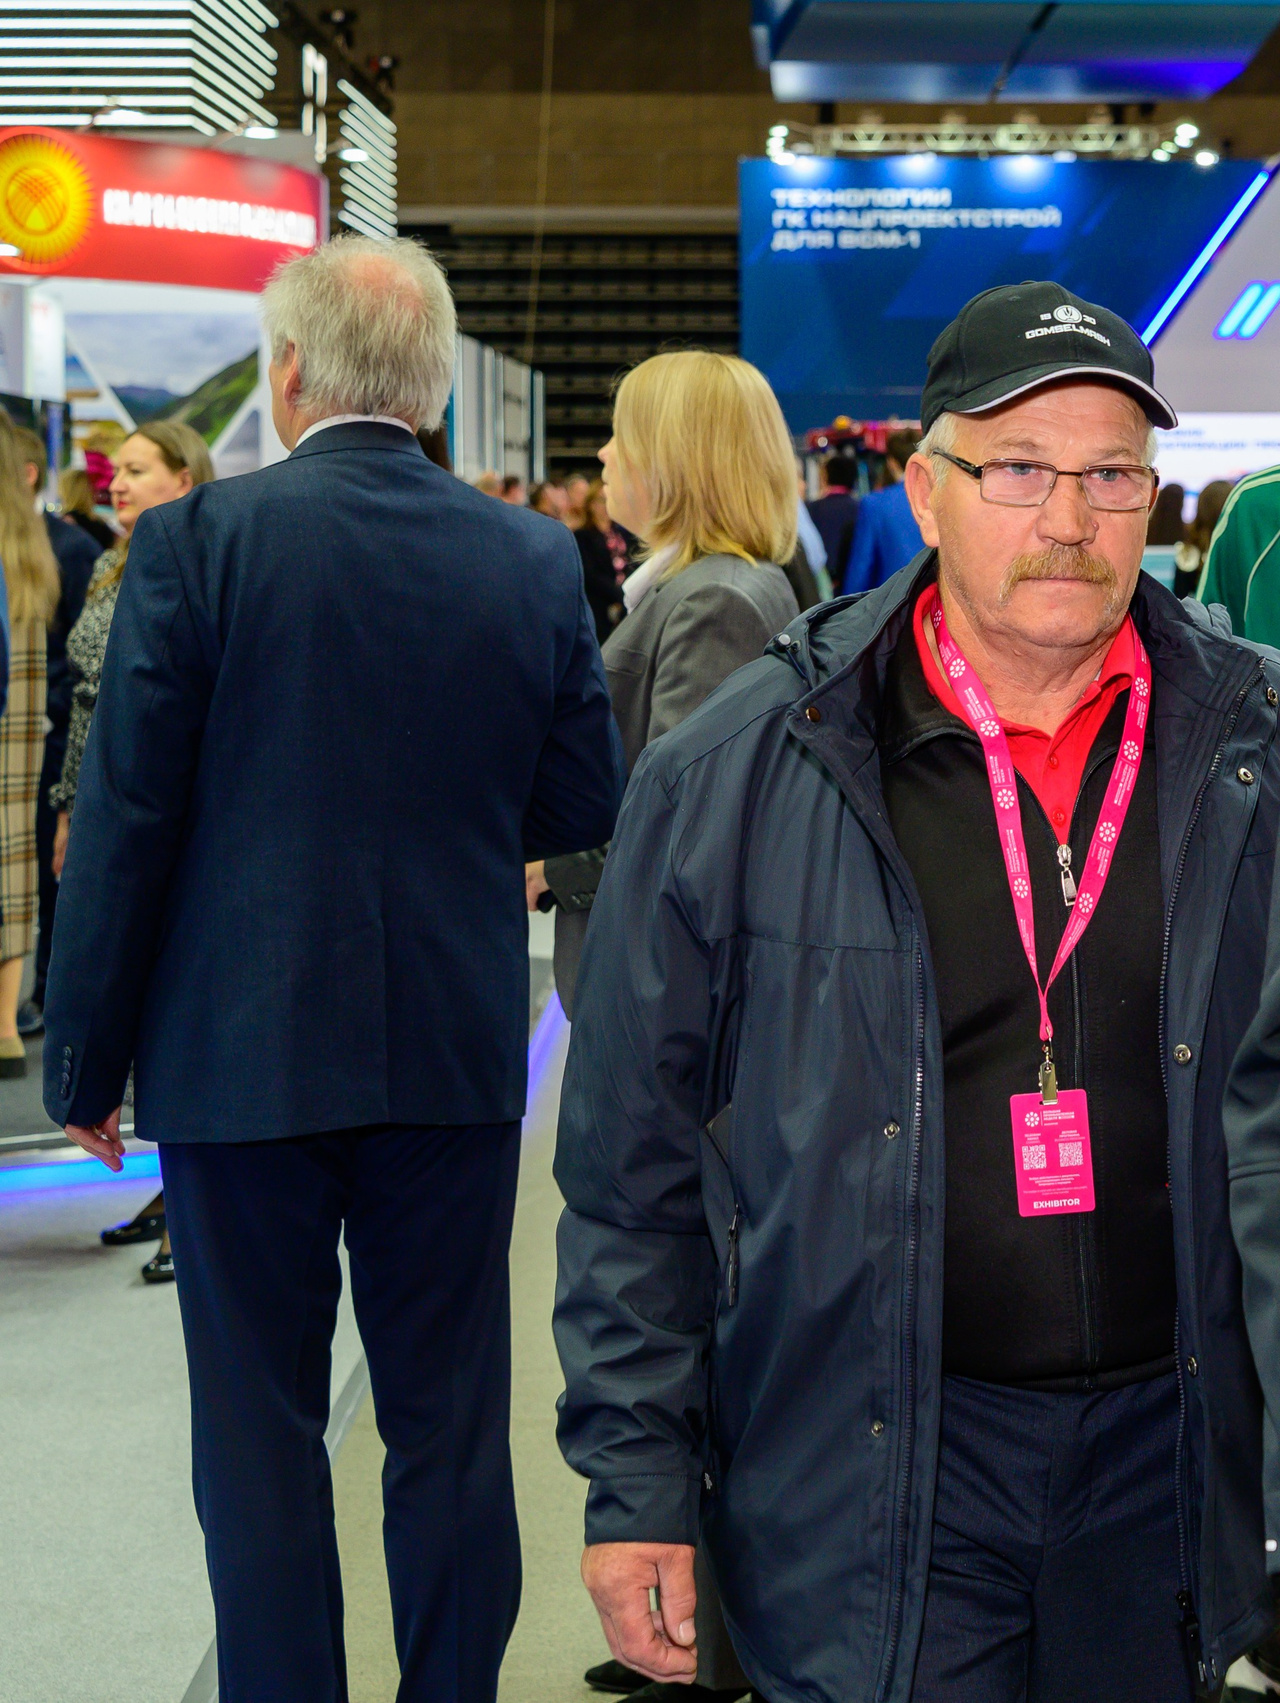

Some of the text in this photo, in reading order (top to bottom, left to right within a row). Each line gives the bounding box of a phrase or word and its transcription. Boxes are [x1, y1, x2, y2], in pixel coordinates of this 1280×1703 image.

[771, 187, 952, 209] ТЕХНОЛОГИИ
[771, 204, 1062, 229] ГК НАЦПРОЕКТСТРОЙ
[770, 229, 835, 252] ДЛЯ
[1033, 1198, 1081, 1210] EXHIBITOR
